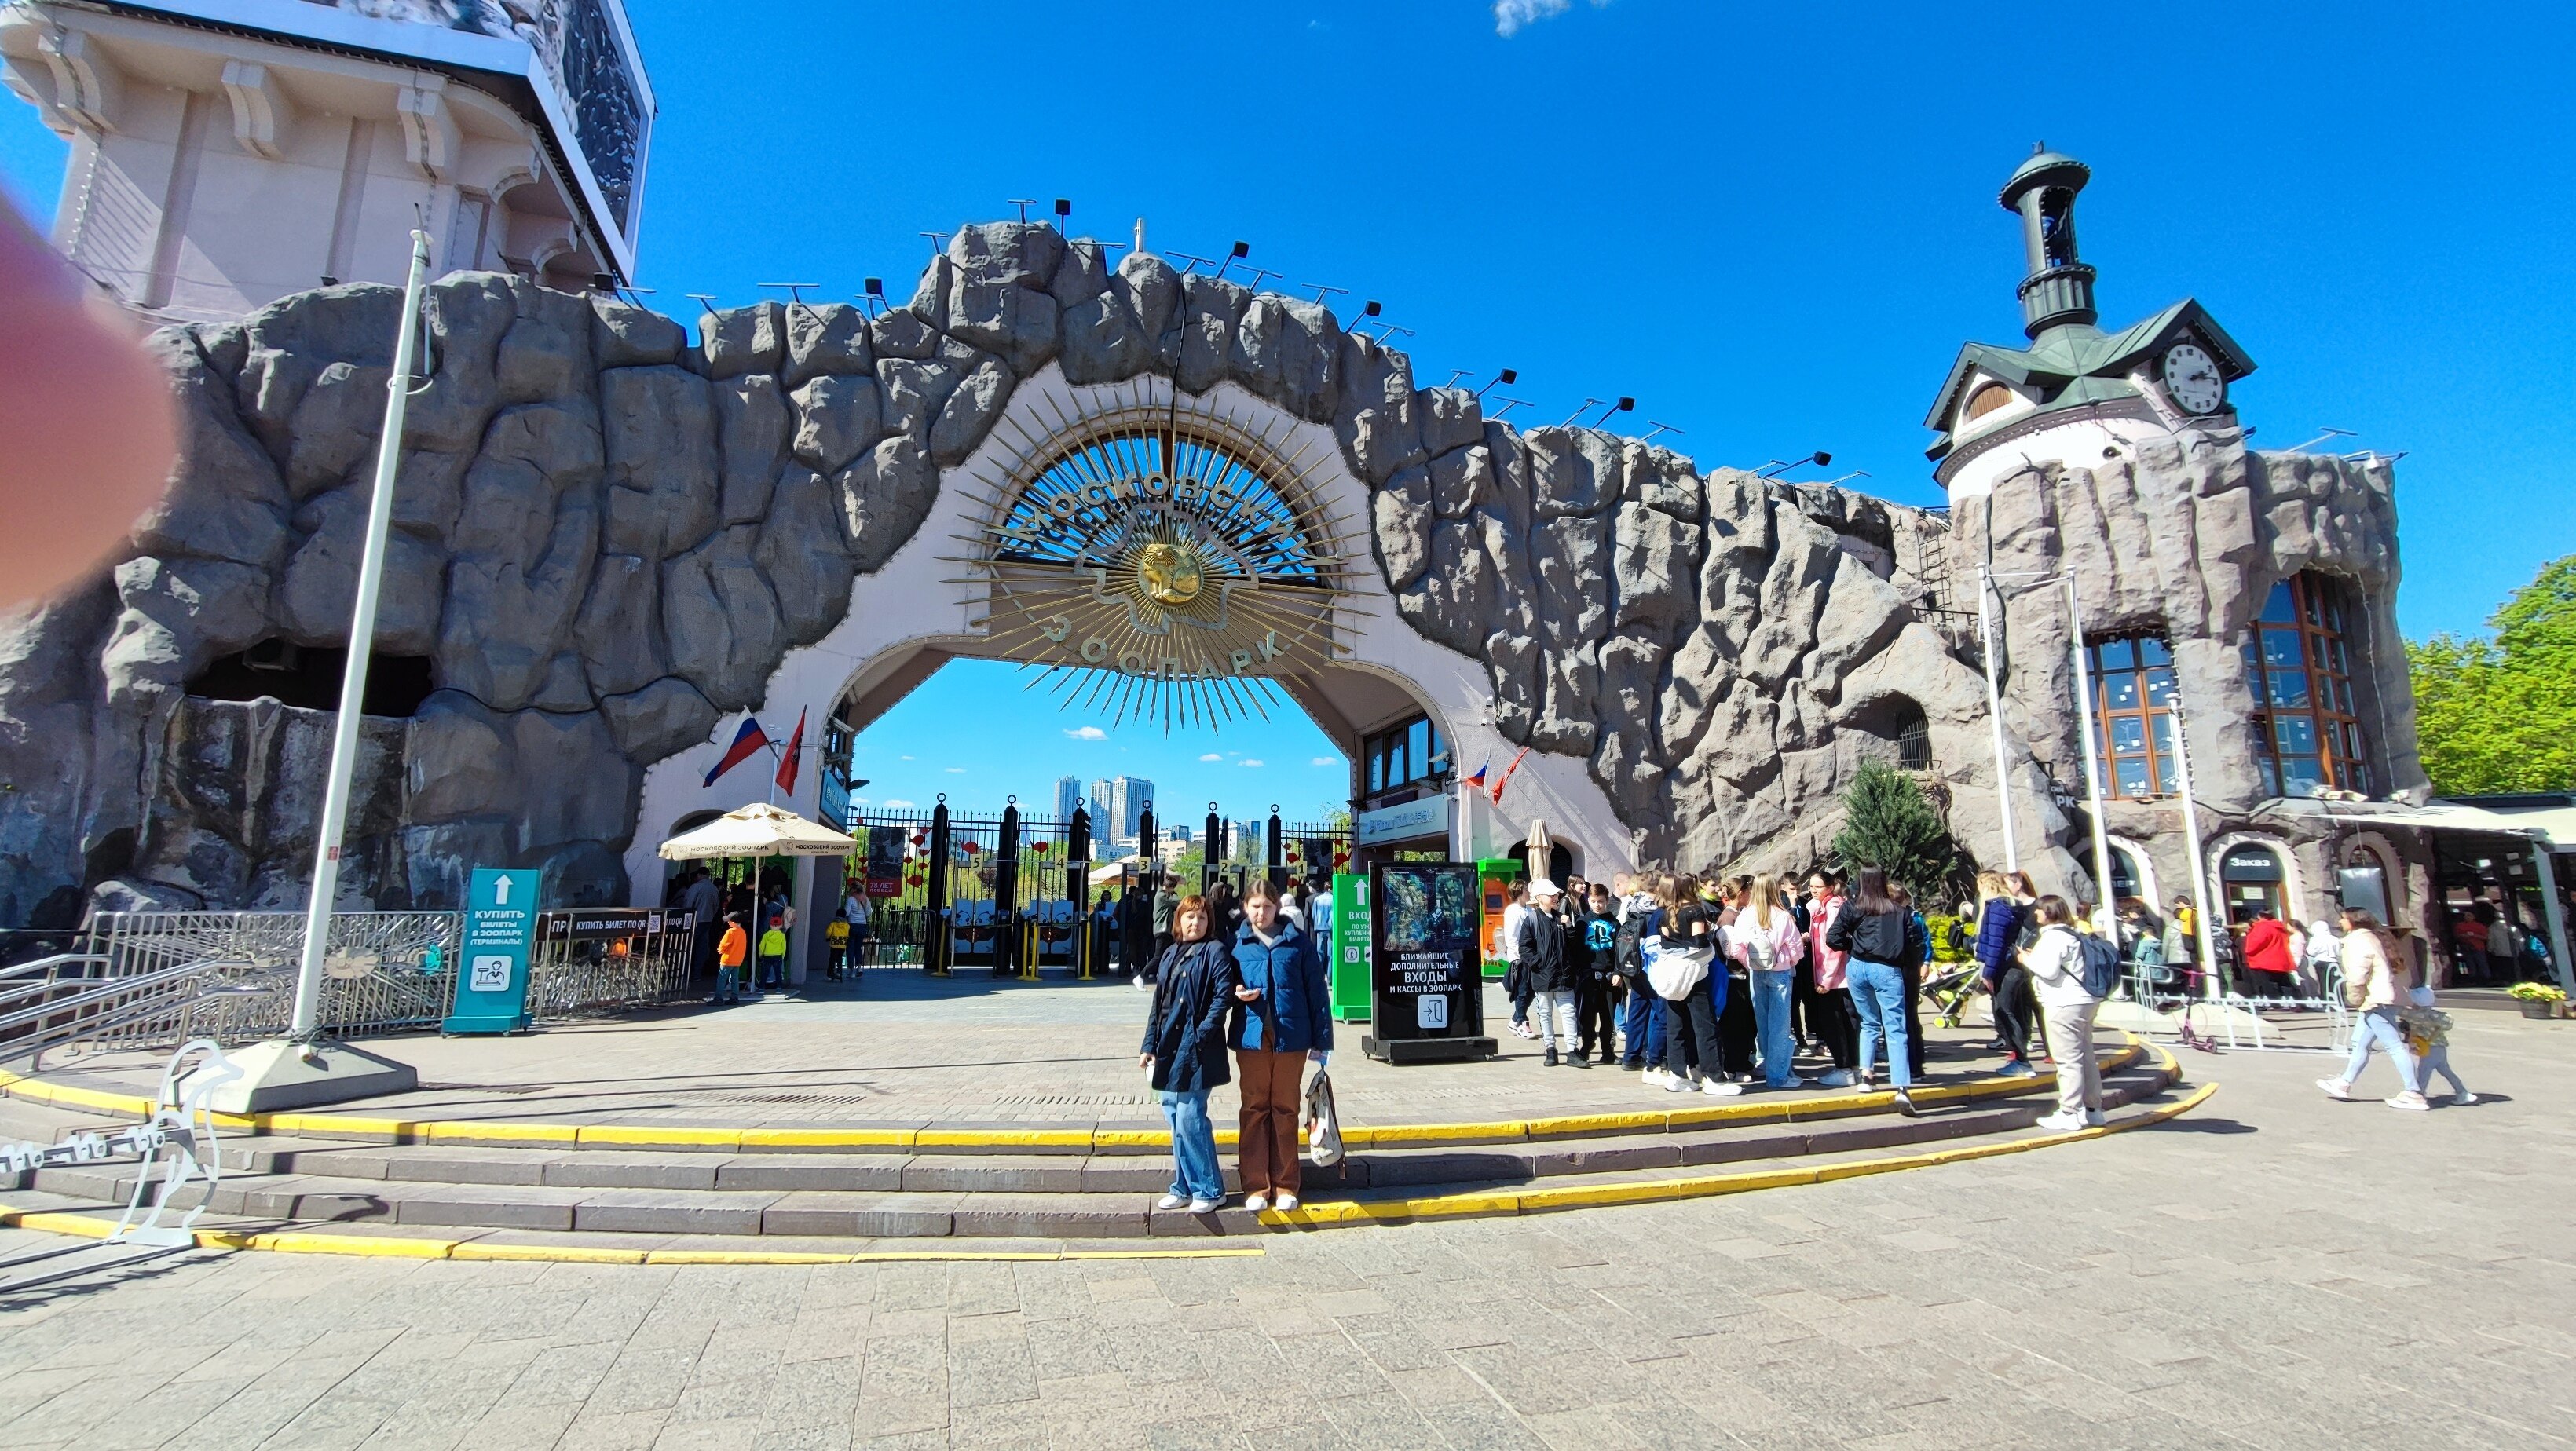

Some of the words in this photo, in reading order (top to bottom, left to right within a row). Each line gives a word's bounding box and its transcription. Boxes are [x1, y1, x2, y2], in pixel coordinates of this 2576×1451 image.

[982, 471, 1348, 566] МОСКОВСКИЙ
[1044, 615, 1285, 682] ЗООПАРК
[974, 857, 980, 868] 5
[1056, 857, 1064, 868] 4
[1140, 861, 1147, 870] 3
[2230, 857, 2270, 867] Заказ
[1221, 863, 1228, 872] 2
[1299, 864, 1304, 874] 1
[552, 920, 568, 933] ПР
[576, 921, 604, 930] КУПИТЬ
[605, 920, 627, 930] БИЛЕТ
[628, 920, 637, 929] ПО
[638, 919, 646, 930] QR
[1400, 952, 1449, 961] БЛИЖАЙШИЕ
[1390, 962, 1460, 971] ДОПОЛНИТЕЛЬНЫЕ
[1404, 970, 1447, 985] ВХОДЫ
[1429, 984, 1462, 992] ЗООПАРК
